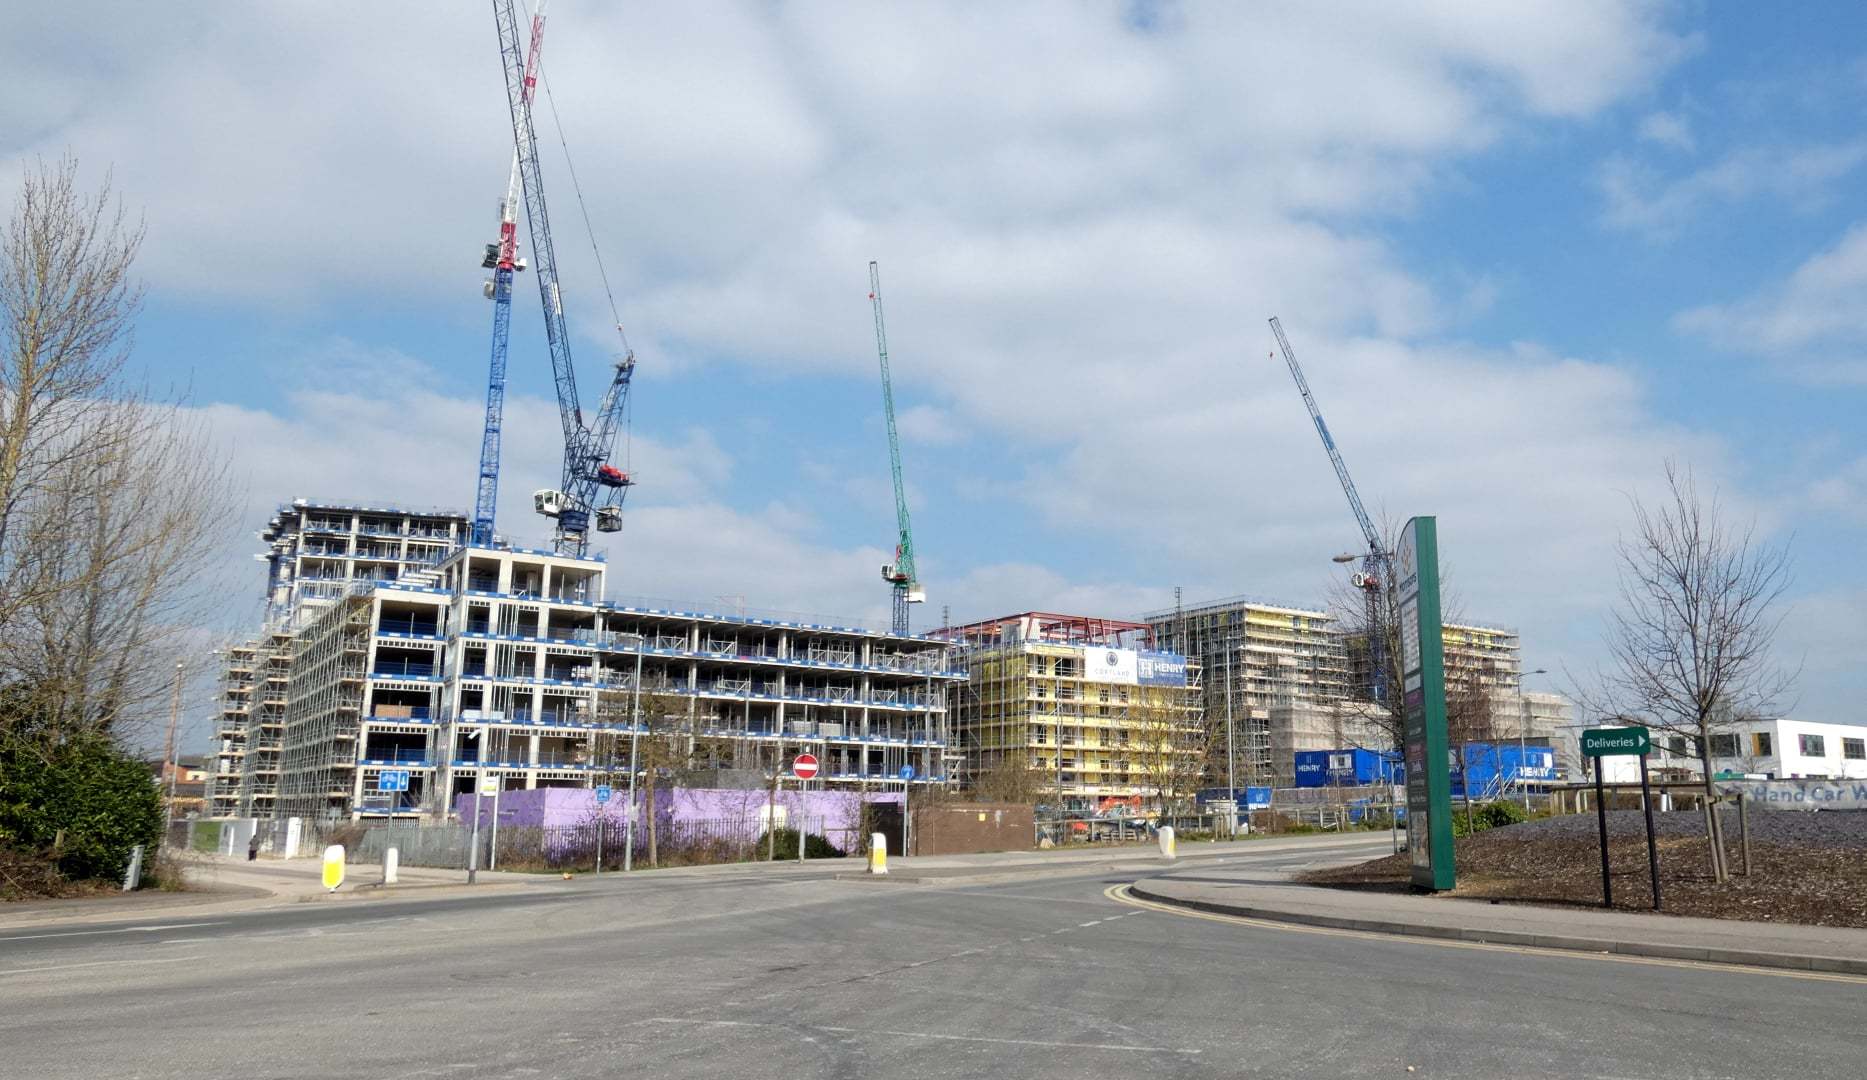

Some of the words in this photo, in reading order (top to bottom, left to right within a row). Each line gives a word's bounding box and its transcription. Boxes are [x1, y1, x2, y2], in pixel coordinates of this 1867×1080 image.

[1154, 661, 1184, 673] HENRY
[1587, 736, 1634, 748] Deliveries
[1753, 783, 1805, 802] Hand
[1811, 784, 1845, 801] Car
